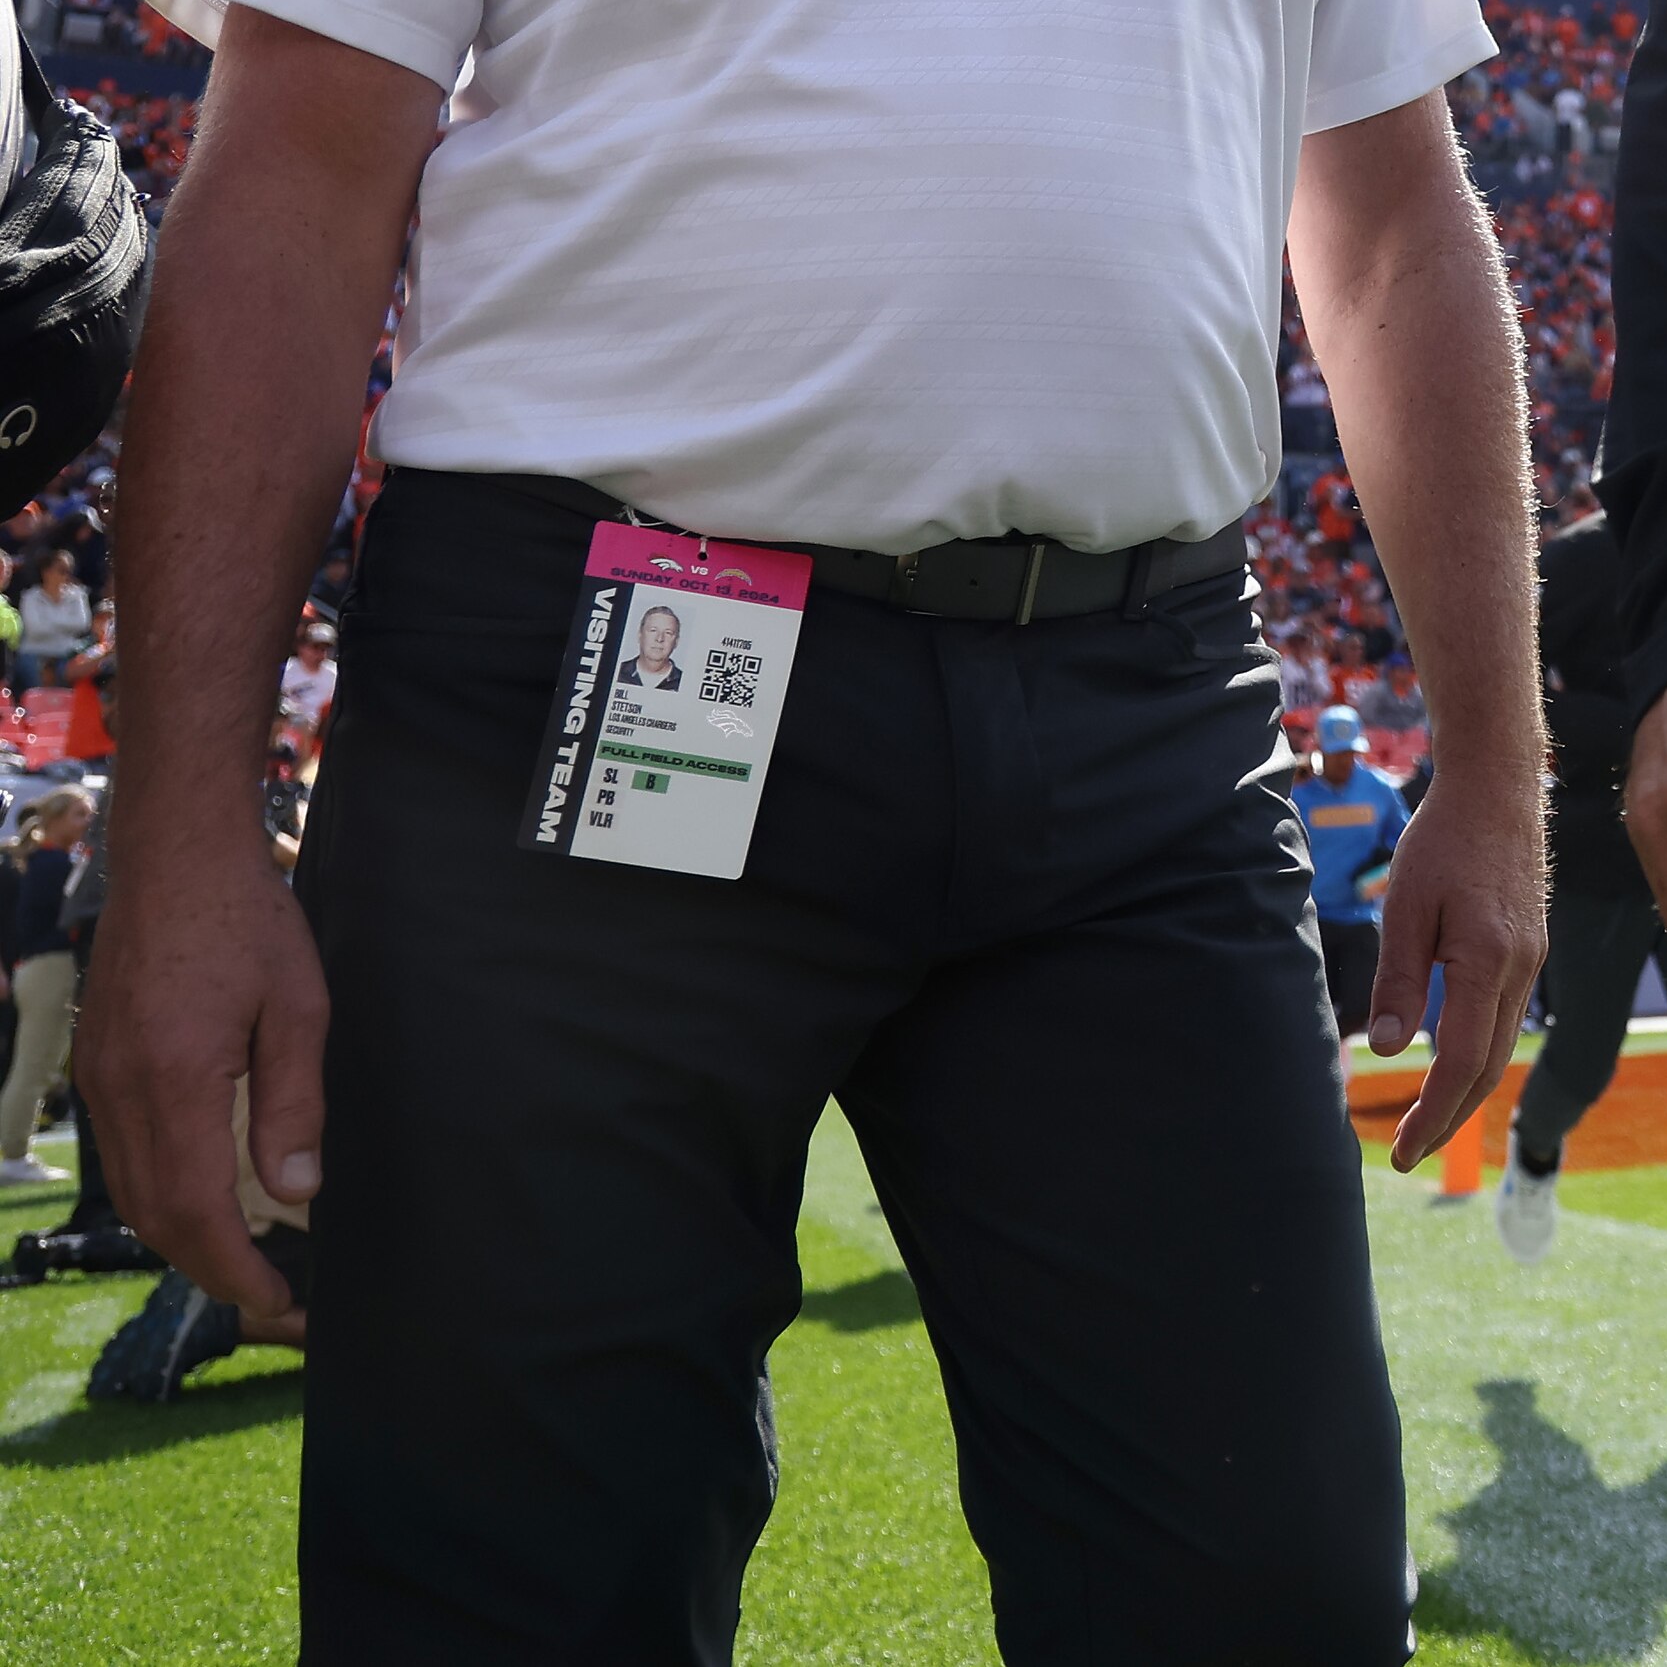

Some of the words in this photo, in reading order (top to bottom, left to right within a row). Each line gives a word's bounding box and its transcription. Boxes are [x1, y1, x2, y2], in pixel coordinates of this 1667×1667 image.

[690, 564, 709, 576] VS
[738, 589, 780, 604] 2024
[563, 587, 617, 735] VISITING
[605, 724, 635, 737] SECURITY
[608, 713, 621, 723] LOS
[621, 715, 647, 727] ANGELES
[646, 718, 677, 732] CHARGERS
[601, 746, 640, 759] FULL
[641, 752, 684, 766] FIELD
[685, 759, 749, 777] ACCESS
[603, 767, 619, 784] SL
[645, 774, 656, 790] B
[536, 741, 582, 843] TEAM
[596, 789, 616, 806] PB
[589, 810, 614, 829] VLR
